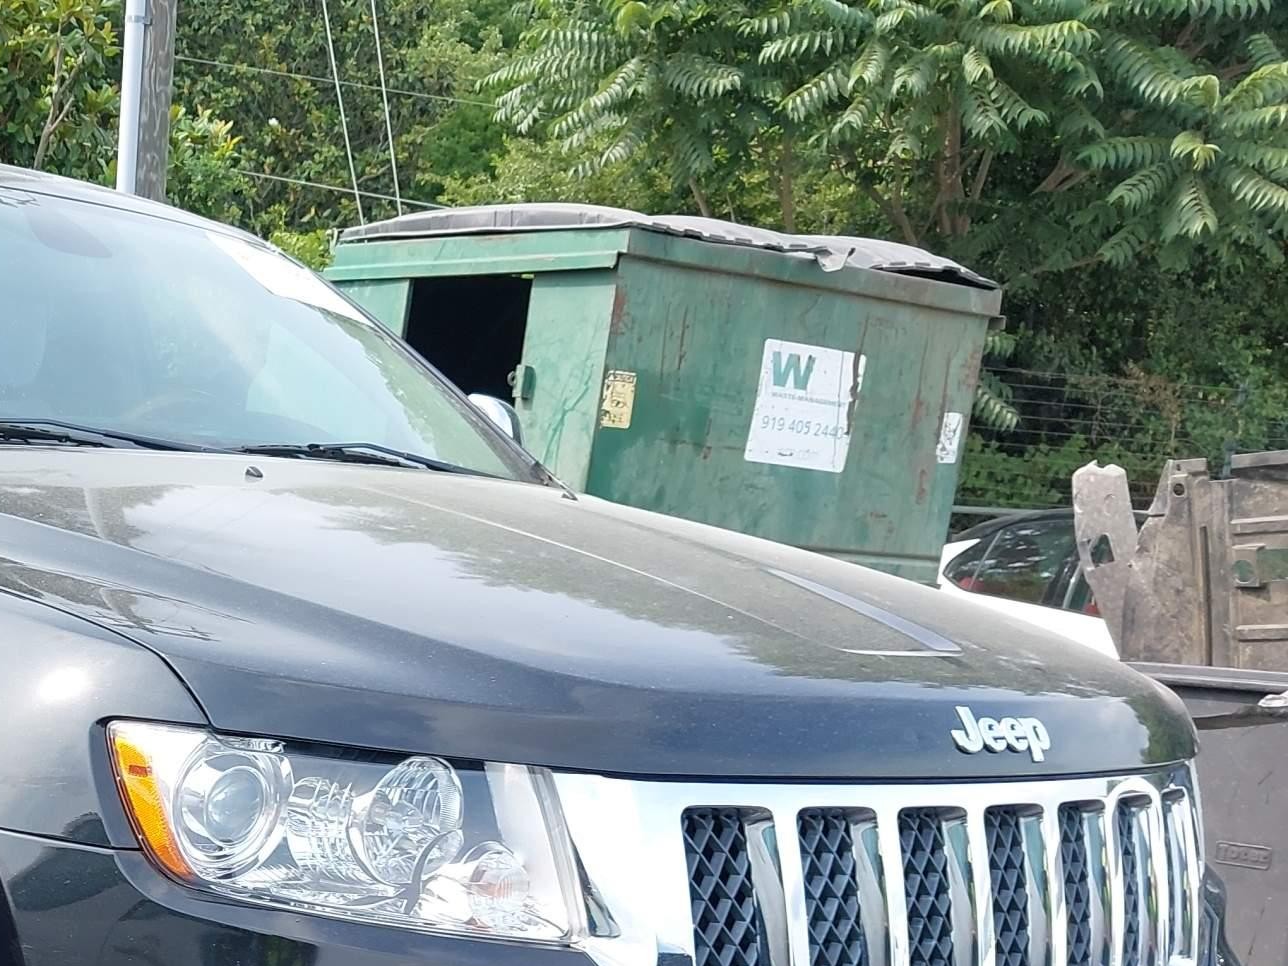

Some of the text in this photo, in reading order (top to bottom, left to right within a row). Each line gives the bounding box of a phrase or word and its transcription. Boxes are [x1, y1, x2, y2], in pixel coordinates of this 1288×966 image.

[761, 415, 785, 432] 919
[788, 419, 811, 435] 405
[951, 705, 1051, 763] Jeep
